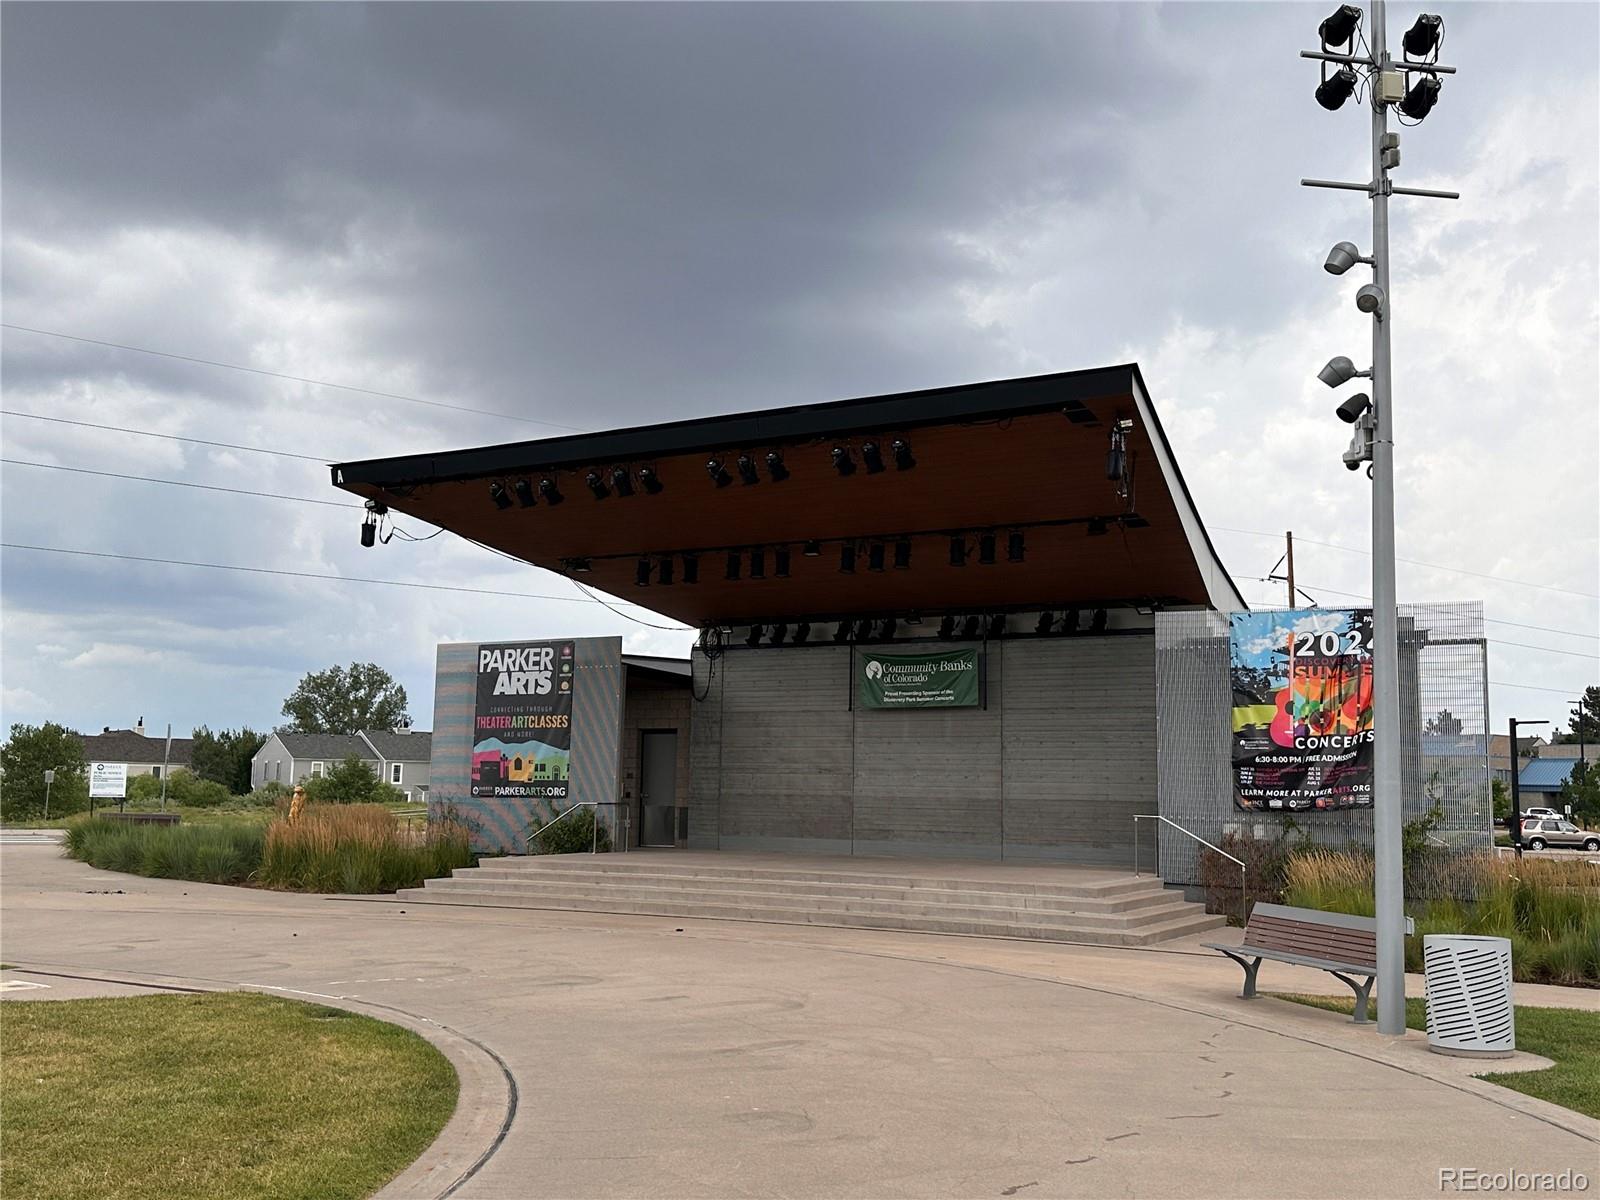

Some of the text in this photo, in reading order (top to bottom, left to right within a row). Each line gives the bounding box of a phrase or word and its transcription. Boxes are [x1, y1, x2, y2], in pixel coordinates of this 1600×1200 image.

[480, 647, 554, 673] PARKER
[882, 660, 973, 675] Community Banks
[493, 671, 552, 695] ARTS
[884, 673, 928, 683] of Colorado
[1295, 731, 1374, 749] CONCERTS
[1255, 755, 1288, 763] 6:30-8:00
[1305, 754, 1320, 762] FREE
[1321, 751, 1358, 762] ADMISSION
[494, 786, 566, 797] PARKERARTS.ORG
[1265, 789, 1288, 797] MORE
[1290, 789, 1301, 797] AT
[1304, 785, 1371, 797] PARKERARTS.ORG
